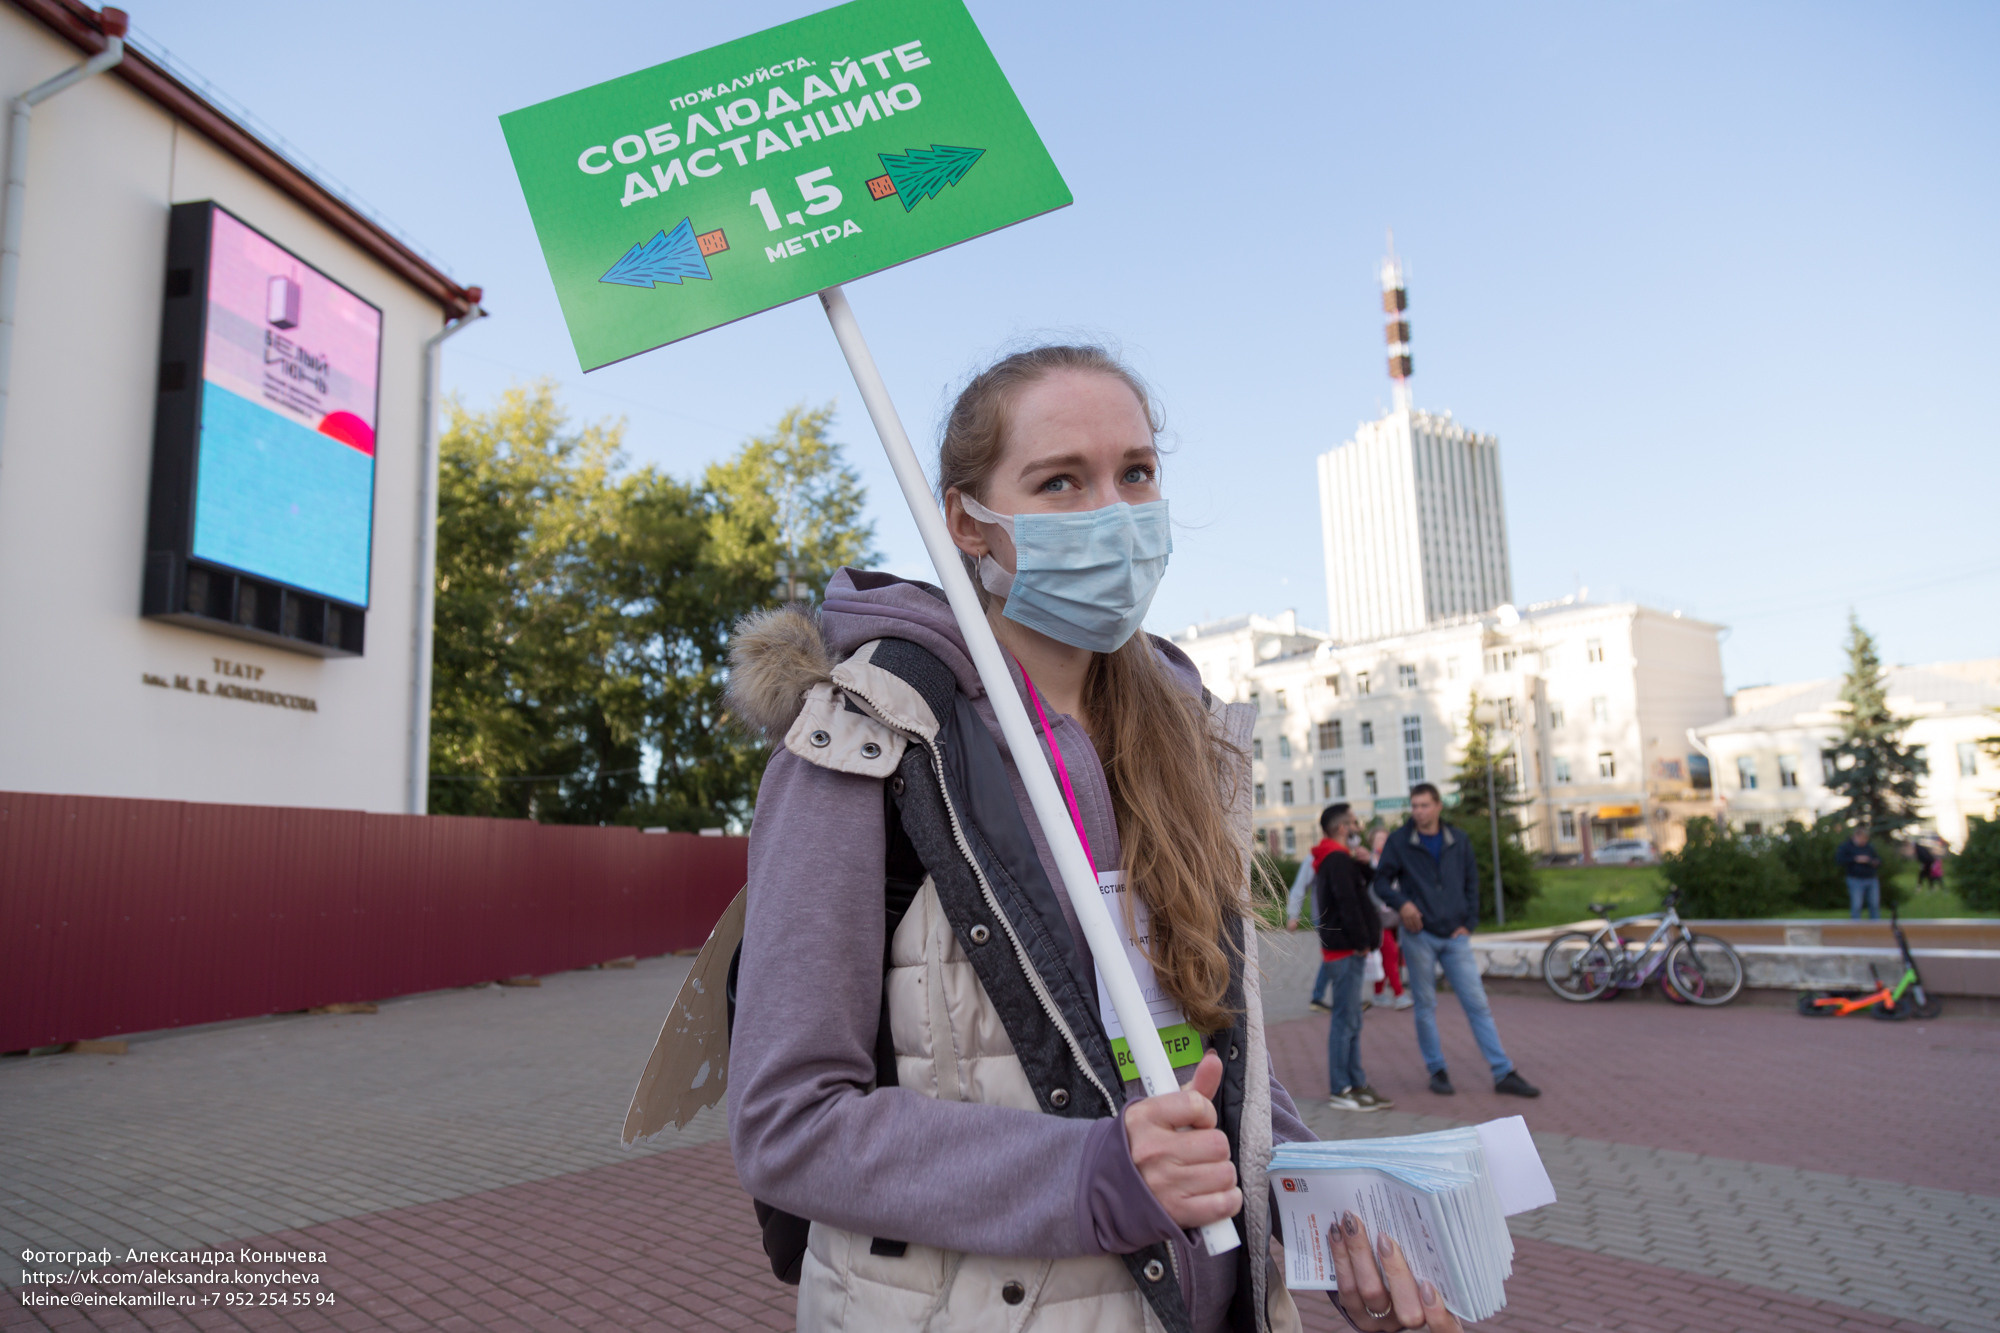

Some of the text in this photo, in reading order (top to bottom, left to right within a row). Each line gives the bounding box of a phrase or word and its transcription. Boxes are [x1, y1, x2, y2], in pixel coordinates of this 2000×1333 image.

[577, 40, 932, 175] СОБЛЮДАЙТЕ
[670, 55, 817, 111] ПОЖАЛУЙСТА,
[620, 82, 922, 208] ДИСТАНЦИЮ
[750, 166, 843, 232] 1,5
[764, 219, 863, 264] МЕТРА
[212, 657, 264, 681] ТЕАТР
[1117, 1036, 1190, 1067] ВОТЕР
